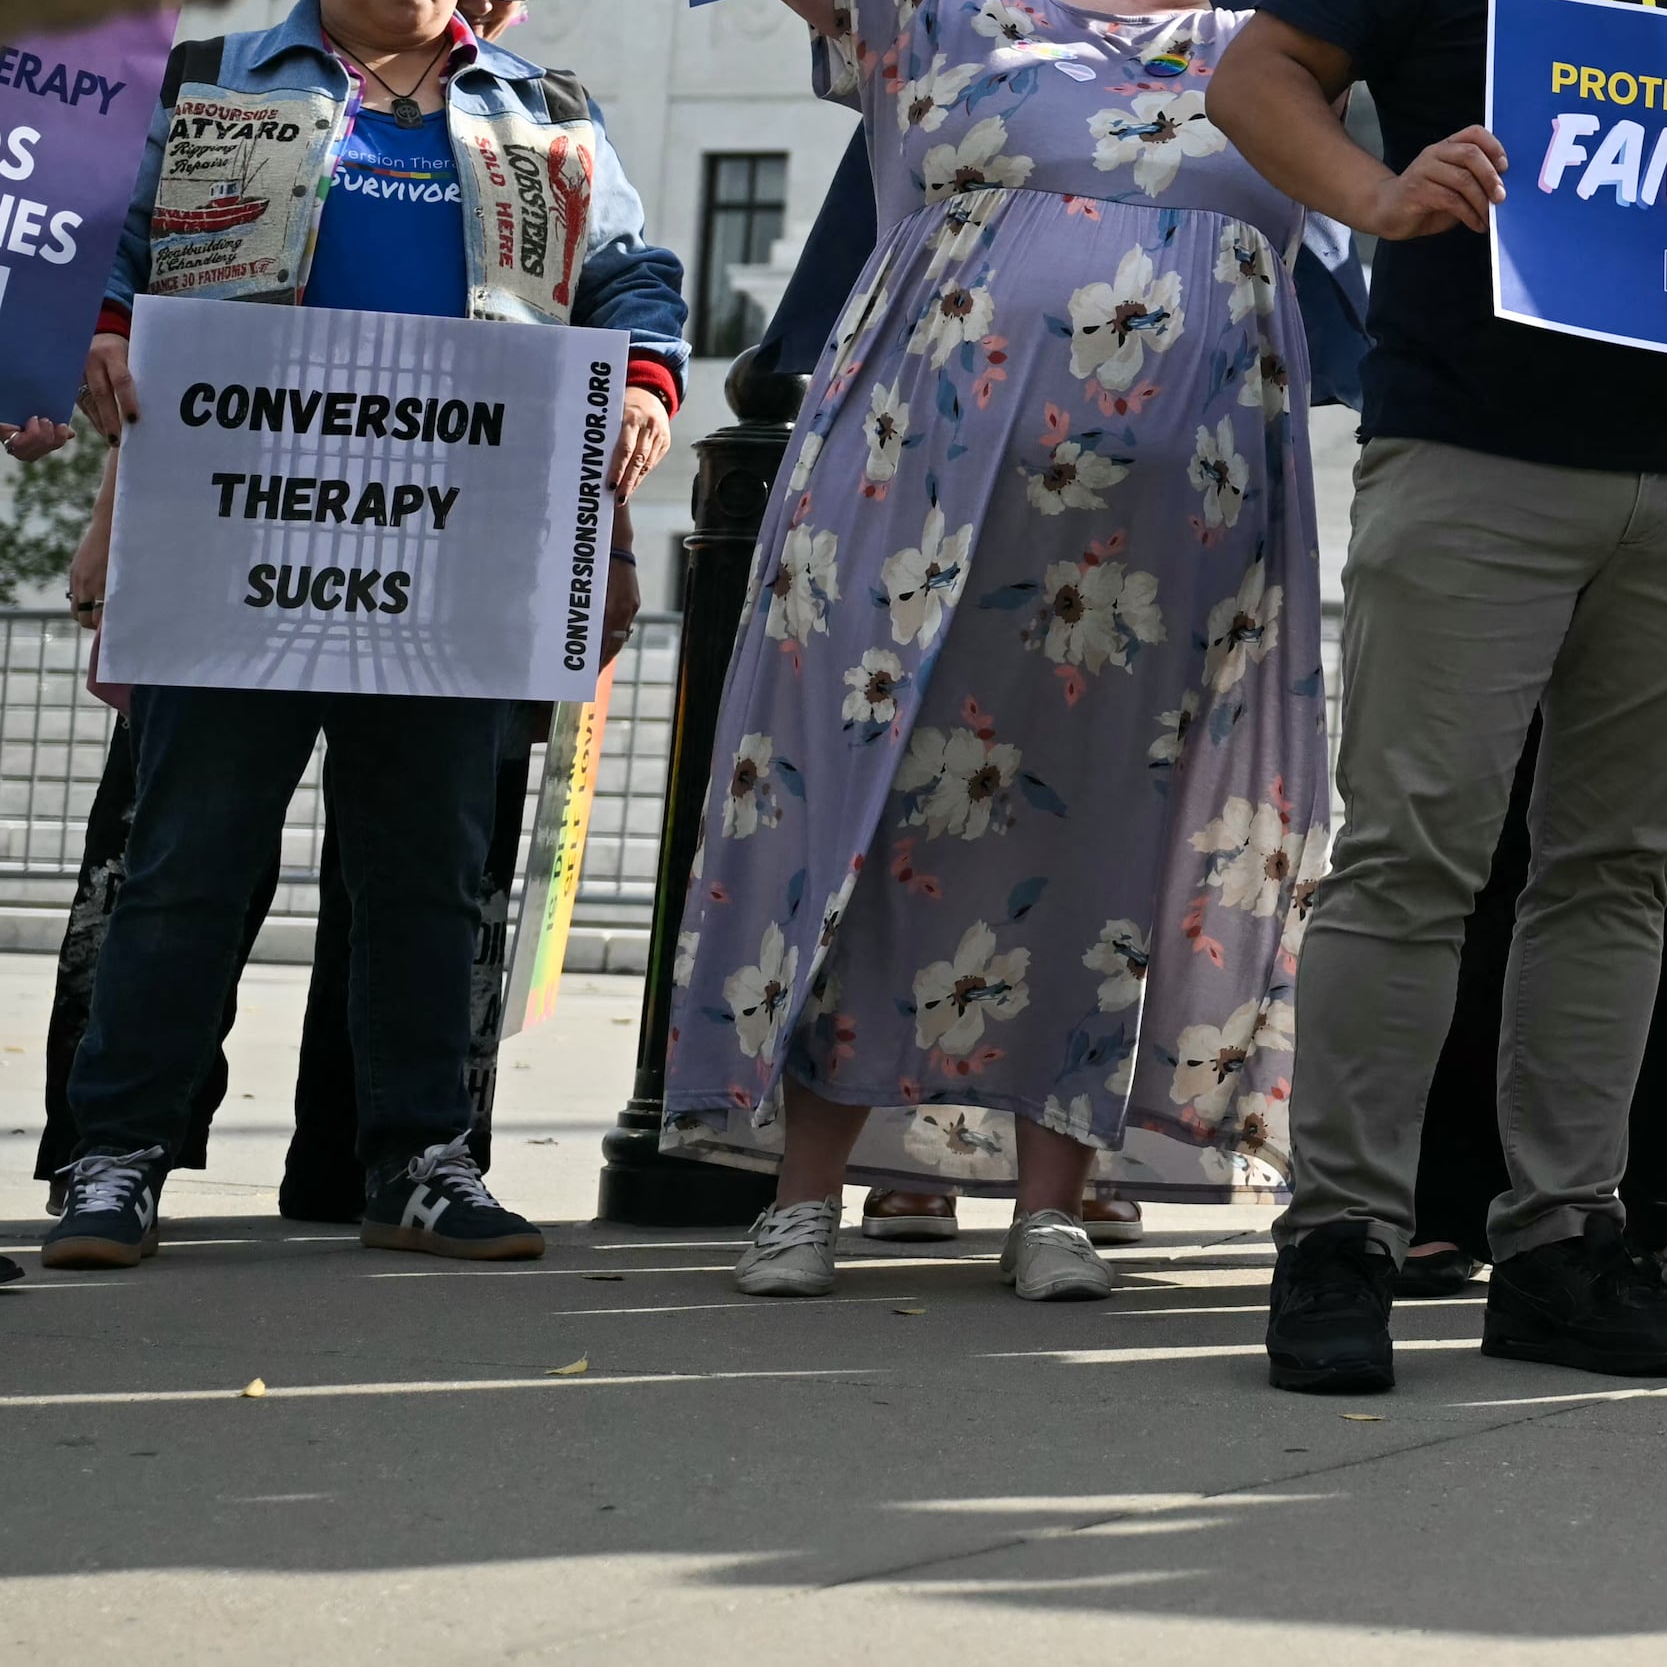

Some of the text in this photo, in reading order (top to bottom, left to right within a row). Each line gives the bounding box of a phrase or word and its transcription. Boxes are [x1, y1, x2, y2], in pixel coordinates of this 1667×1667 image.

[475, 135, 514, 270] SOLD HERE
[179, 382, 505, 447] CONVERSION
[211, 472, 460, 531] THERAPY
[562, 361, 612, 671] CONVERSIONSURVIVOR.ORG
[244, 563, 411, 614] SUCKS
